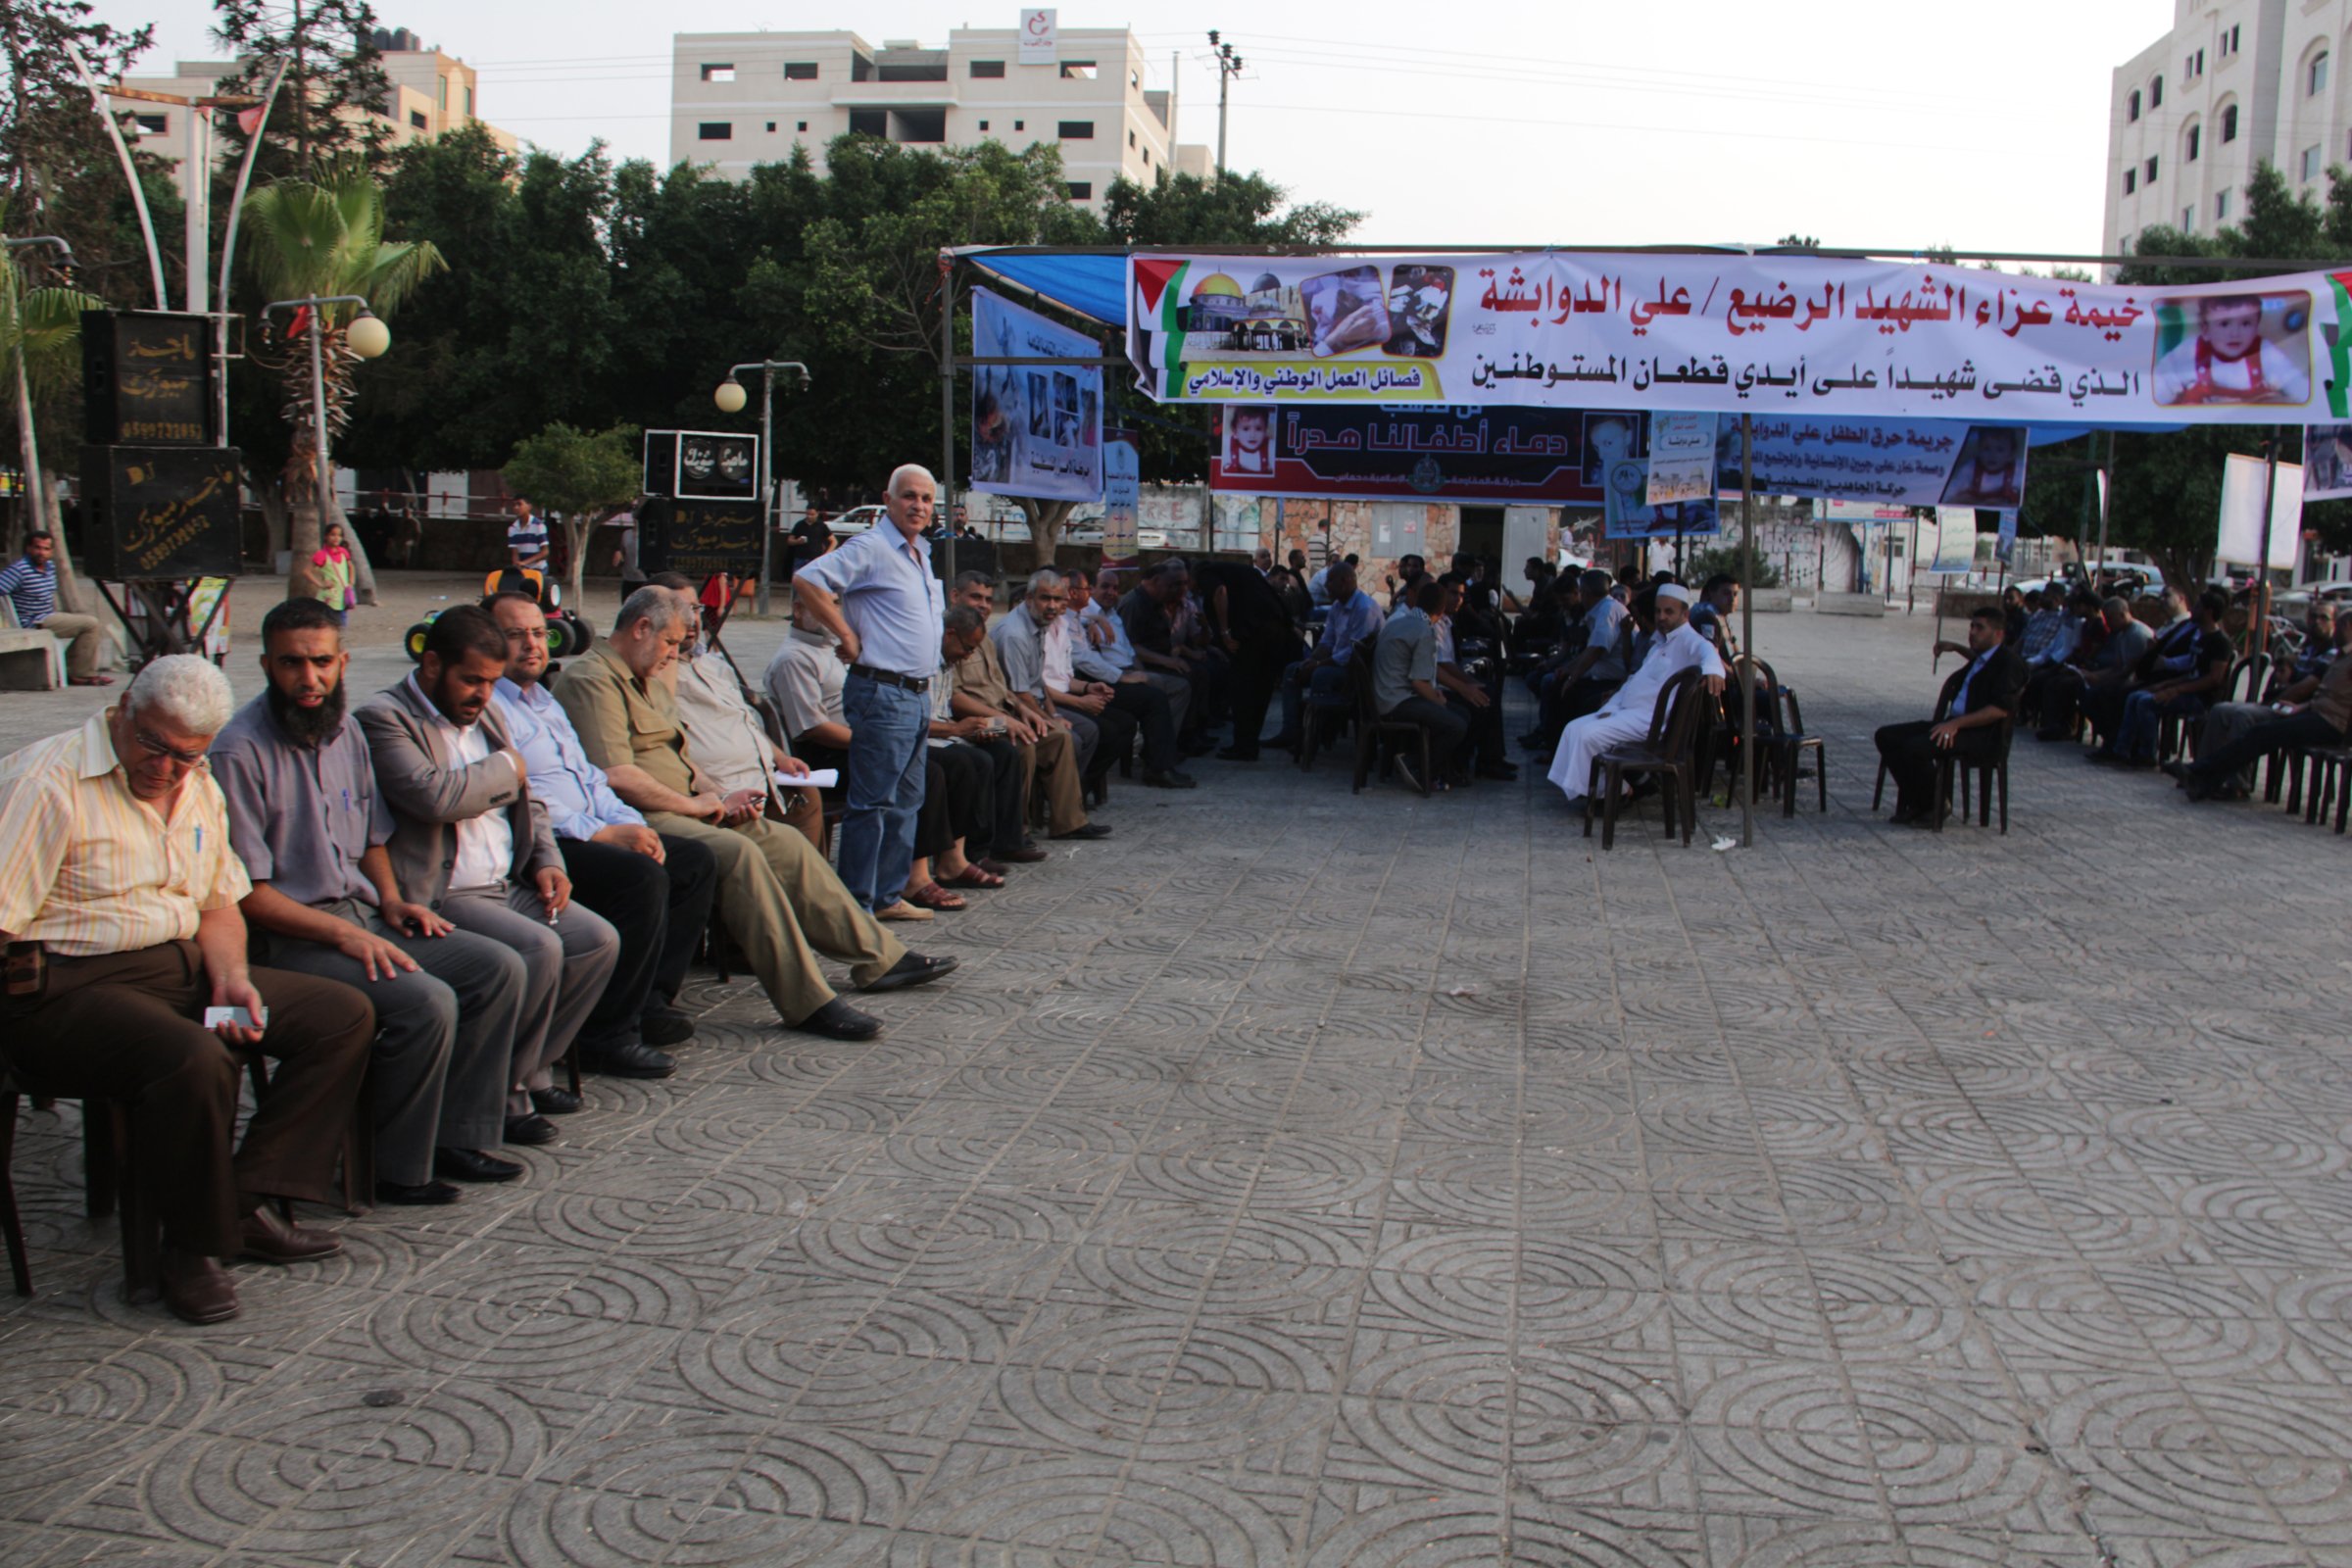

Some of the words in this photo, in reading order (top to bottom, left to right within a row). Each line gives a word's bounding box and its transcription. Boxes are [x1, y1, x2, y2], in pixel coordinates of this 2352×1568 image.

[1478, 267, 1621, 328] الدوابشة
[1629, 275, 1692, 336] علي
[1727, 280, 1844, 336] الرضيع
[1855, 274, 1965, 335] الشهيد
[1975, 288, 2052, 337] عزاء
[2059, 287, 2144, 342] خيمة
[1189, 368, 1260, 395] والإسلامي
[1263, 368, 1321, 395] الوطني
[1325, 369, 1367, 391] العمل
[1370, 368, 1421, 391] فصائل
[1472, 352, 1626, 390] المستوطنين
[1633, 354, 1729, 391] قطعان
[1735, 355, 1805, 399] أيدي
[1812, 363, 1878, 396] على
[1983, 365, 2062, 399] قضى
[2069, 368, 2139, 407] الذي
[1367, 418, 1488, 454] أطفالنا
[1494, 425, 1568, 456] دماء
[1823, 423, 1869, 445] الطفل
[1870, 427, 1903, 449] حرق
[1907, 428, 1954, 453] جريمة
